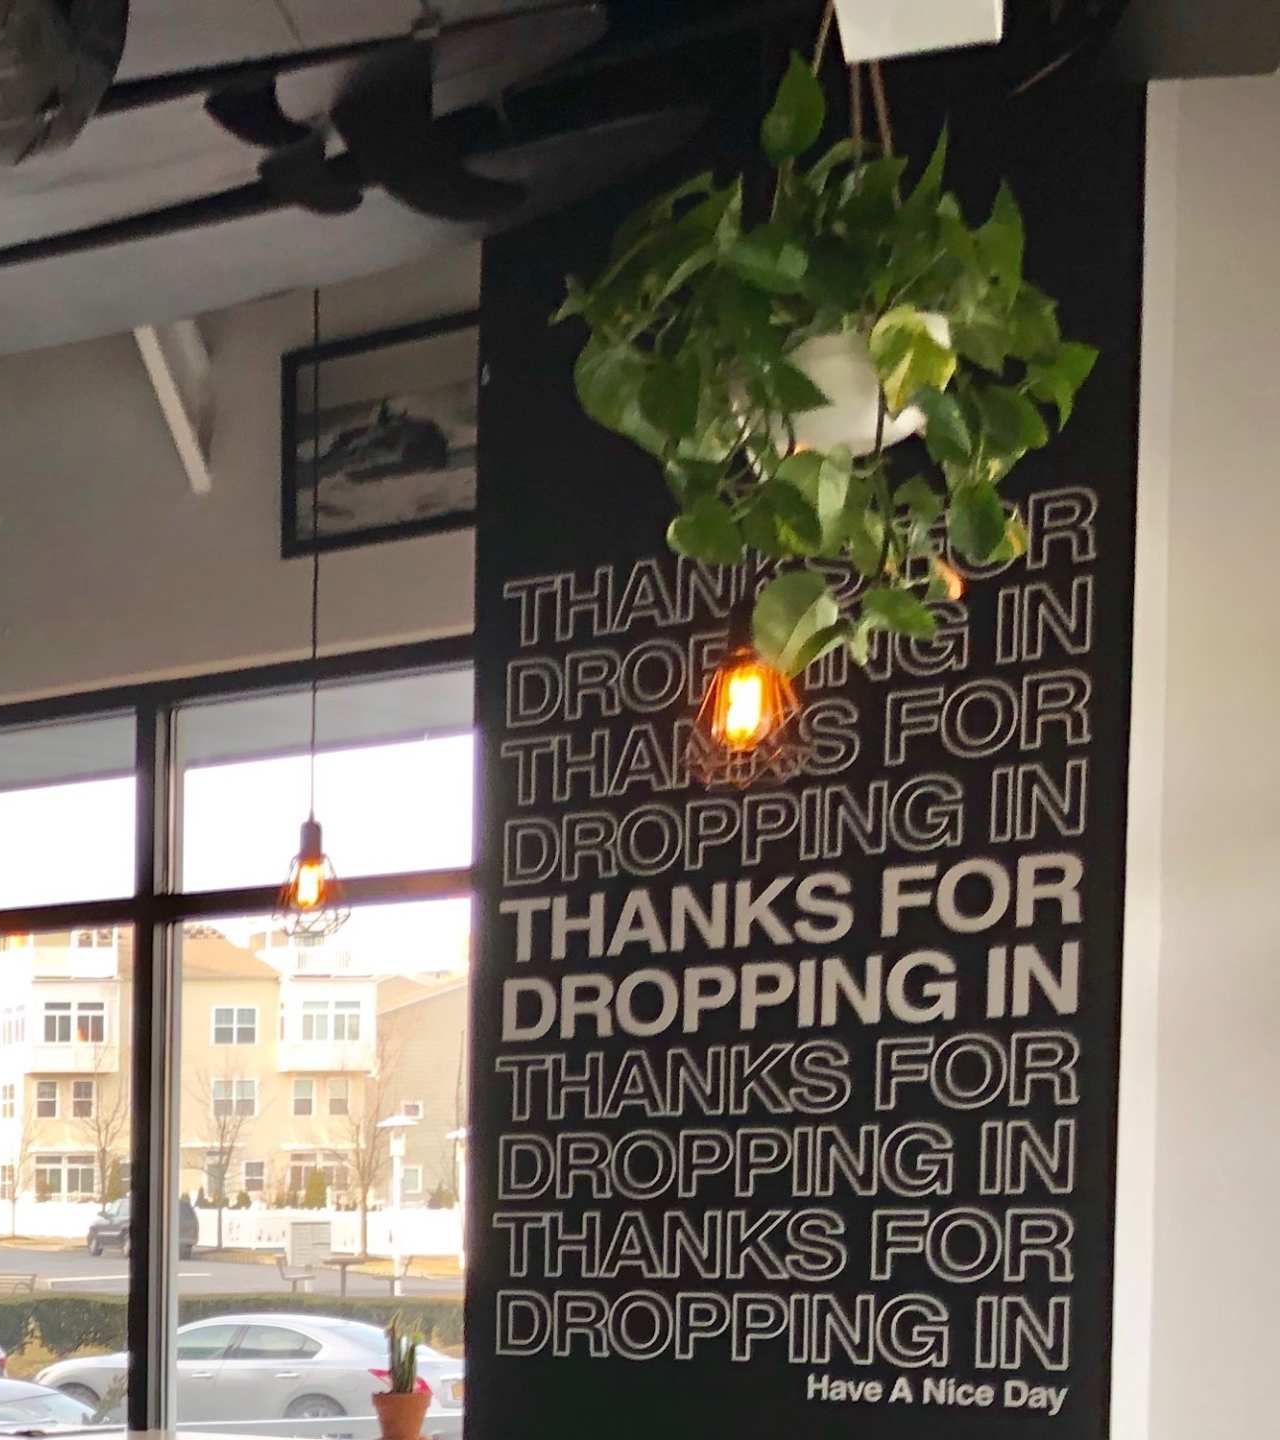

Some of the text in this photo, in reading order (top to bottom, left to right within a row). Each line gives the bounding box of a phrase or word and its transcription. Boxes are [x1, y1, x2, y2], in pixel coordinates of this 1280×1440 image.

[503, 538, 864, 648] THAN
[506, 575, 1094, 729] DROPING IN
[884, 668, 1092, 767] FOR
[502, 757, 1088, 888] DROPPING IN
[499, 851, 1085, 963] THANKS FOR
[501, 941, 1080, 1043] DROPPING IN
[495, 1030, 1081, 1121] THANKS FOR
[498, 1118, 1075, 1200] DROPPING IN
[492, 1207, 1075, 1283] THANKS FOR
[495, 1289, 1071, 1371] DROPPING IN
[807, 1373, 1070, 1416] Have A Nice Day
